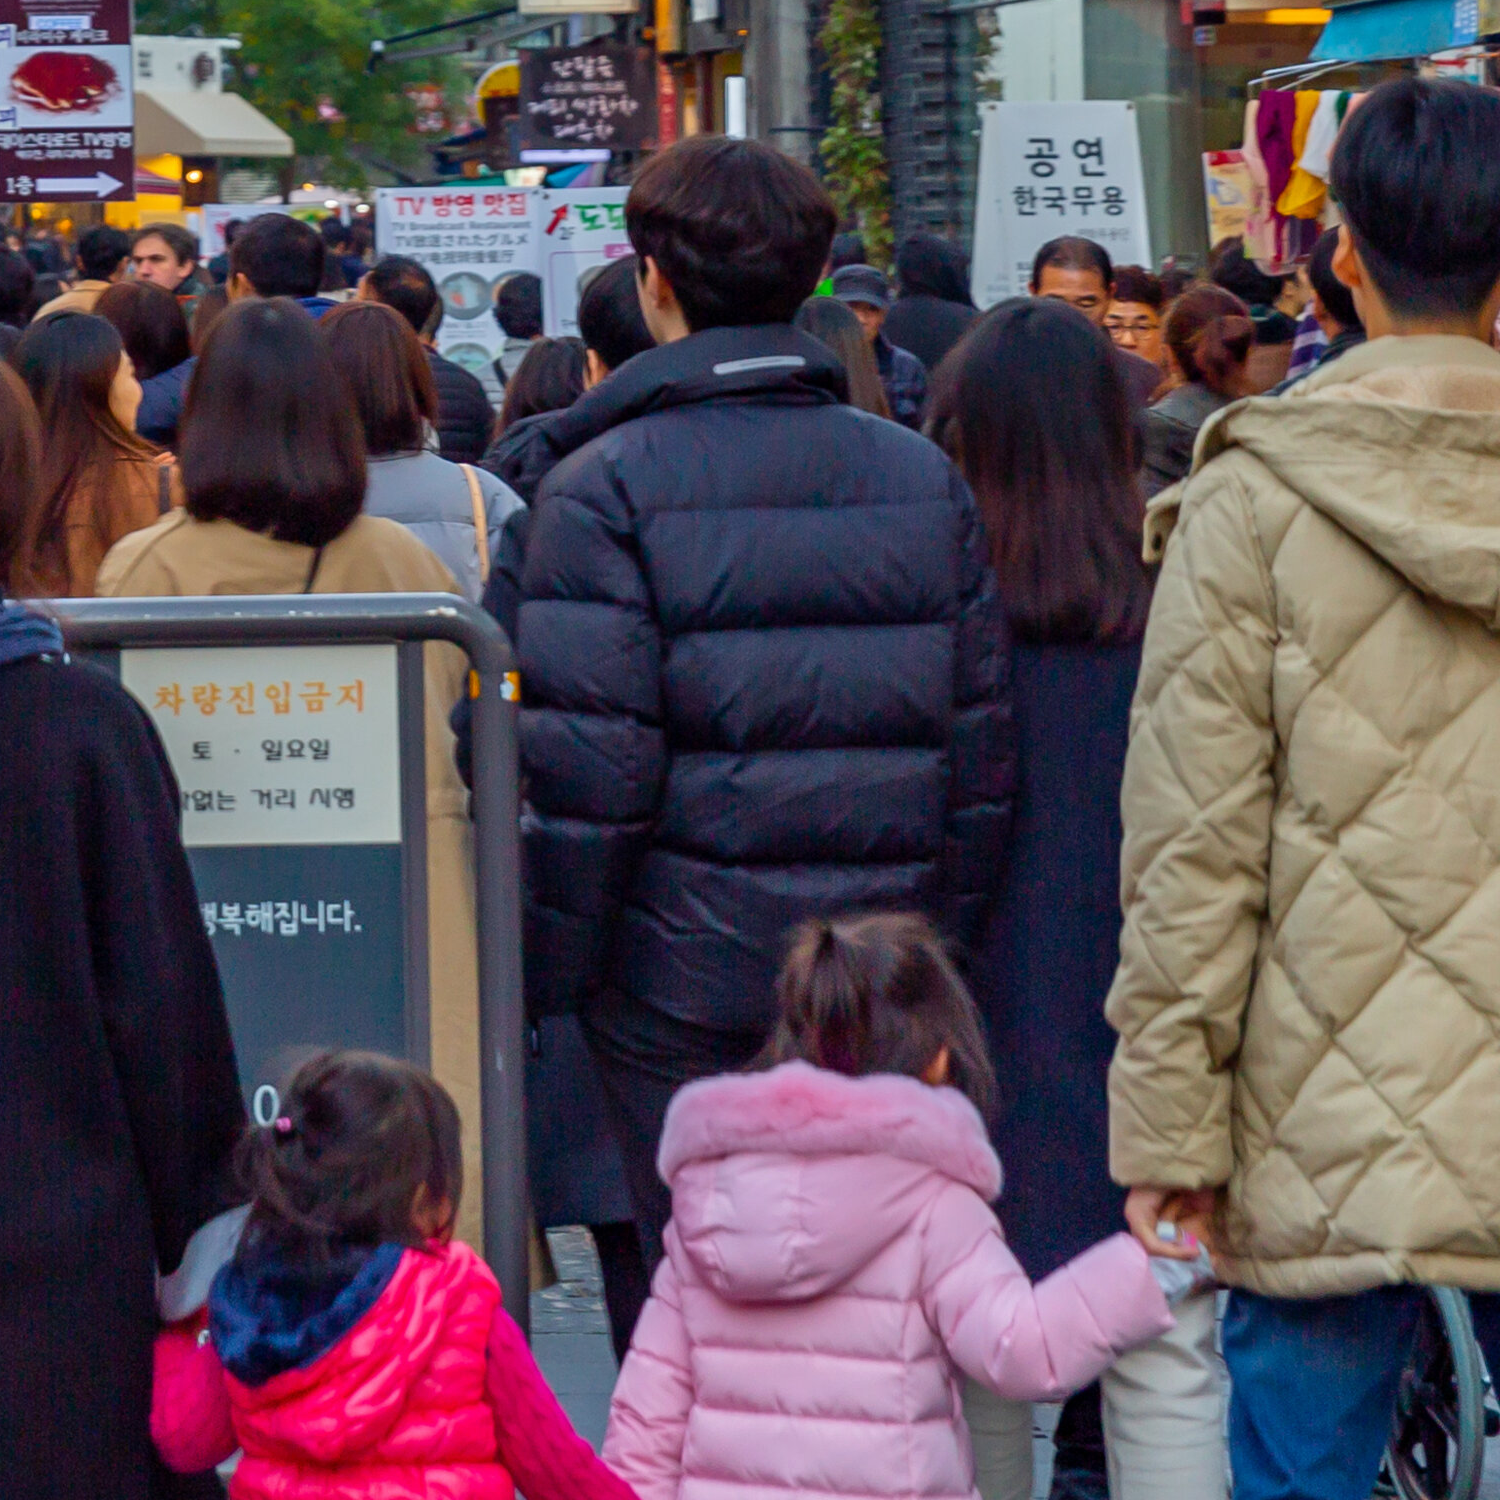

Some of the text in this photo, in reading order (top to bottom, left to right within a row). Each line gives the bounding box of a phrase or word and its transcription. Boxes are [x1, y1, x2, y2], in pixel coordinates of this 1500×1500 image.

[1024, 136, 1107, 178] 공연
[5, 175, 34, 196] 1층
[395, 193, 527, 217] TV 방영 맛집
[1011, 185, 1128, 217] 한국무용
[153, 679, 366, 717] 차량진입금지
[192, 741, 213, 761] 토
[261, 738, 331, 762] 일요일
[250, 788, 296, 809] 거리
